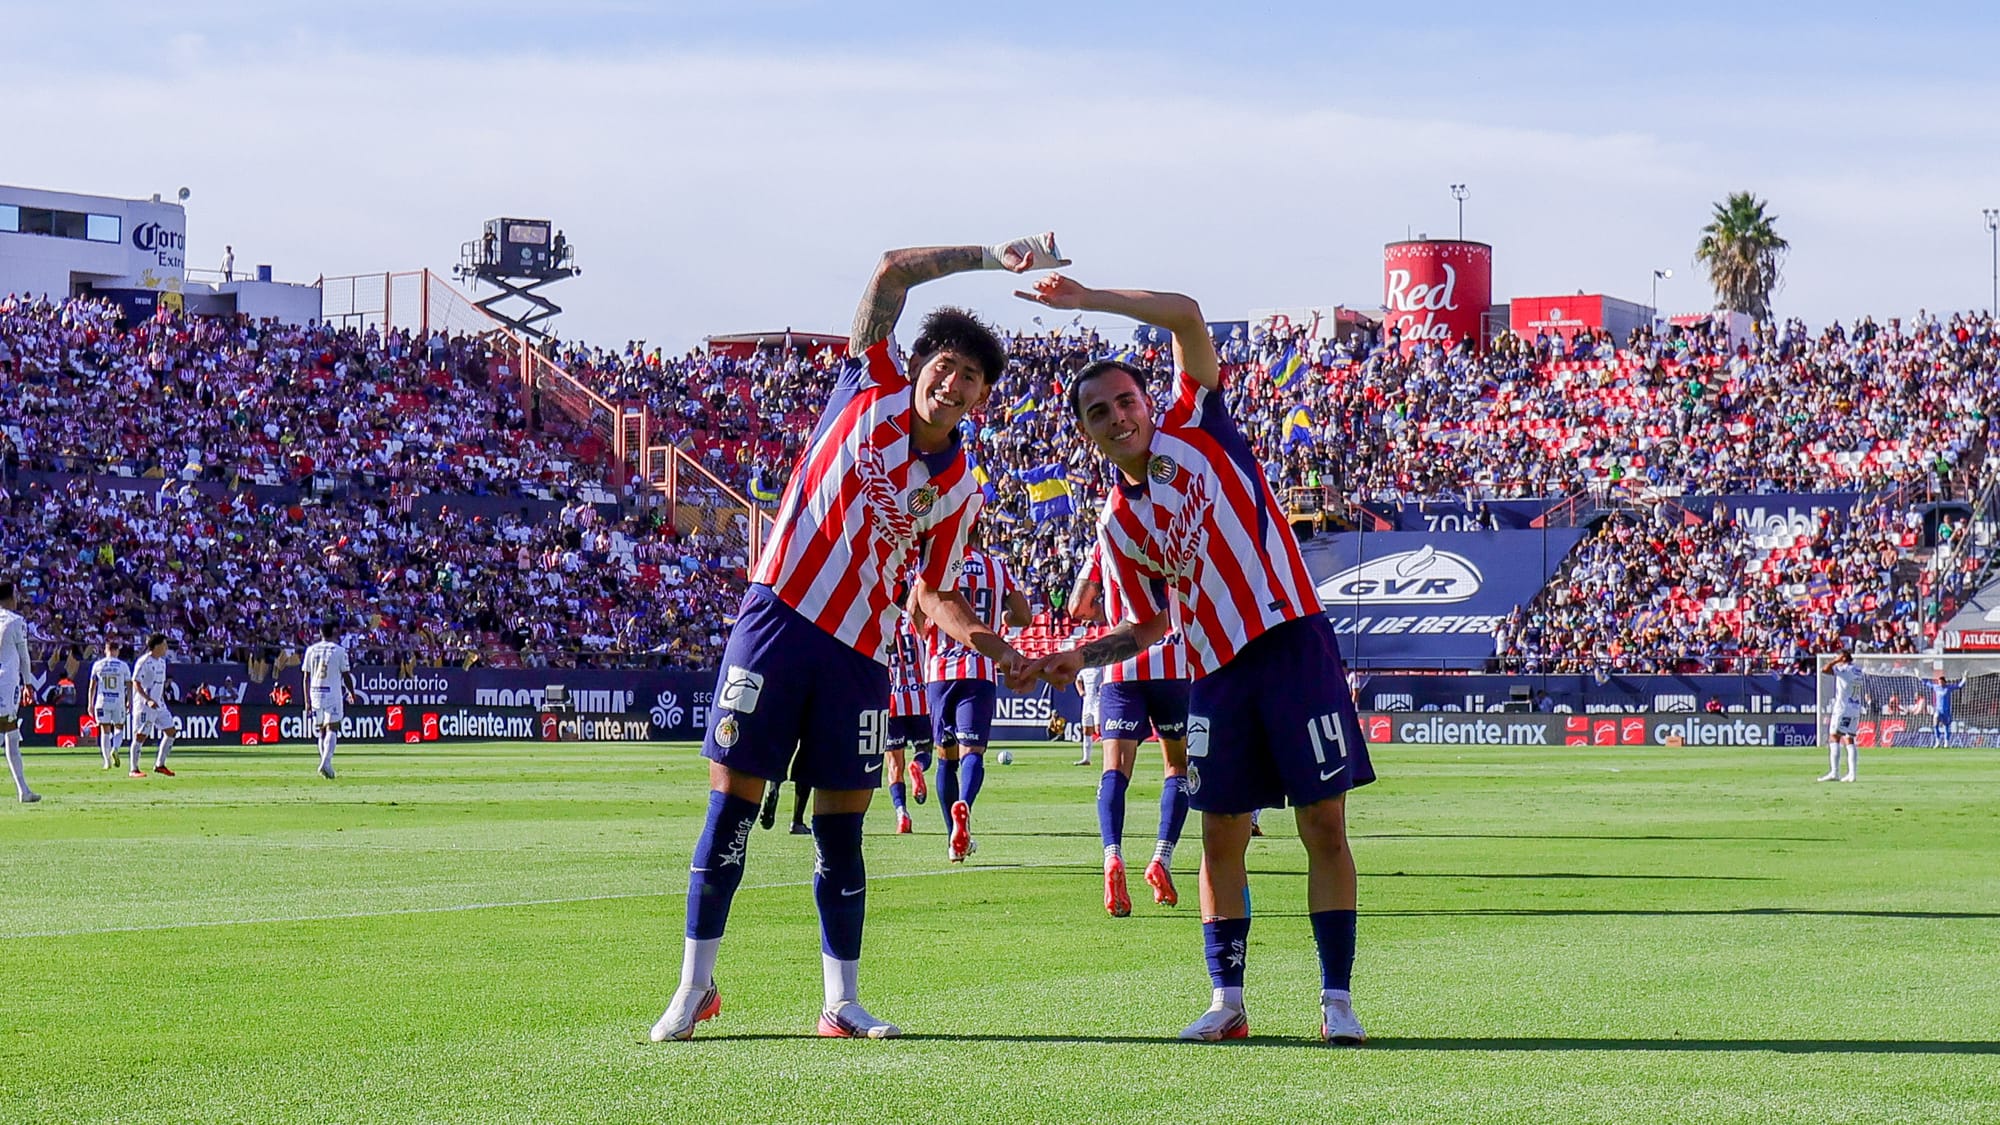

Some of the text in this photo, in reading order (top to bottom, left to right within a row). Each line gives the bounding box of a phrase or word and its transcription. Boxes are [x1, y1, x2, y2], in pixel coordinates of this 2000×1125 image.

[1386, 263, 1458, 311] Red
[1399, 312, 1448, 341] Cola
[1339, 578, 1458, 595] GVR
[1368, 616, 1418, 634] DE
[1408, 615, 1504, 634] REYES
[102, 675, 117, 689] 10
[361, 672, 449, 691] Laboratorio
[996, 698, 1051, 719] NESS
[439, 709, 534, 738] caliente.mx
[1105, 718, 1138, 731] telcel
[1400, 716, 1548, 745] caliente.mx
[1307, 712, 1347, 764] 14
